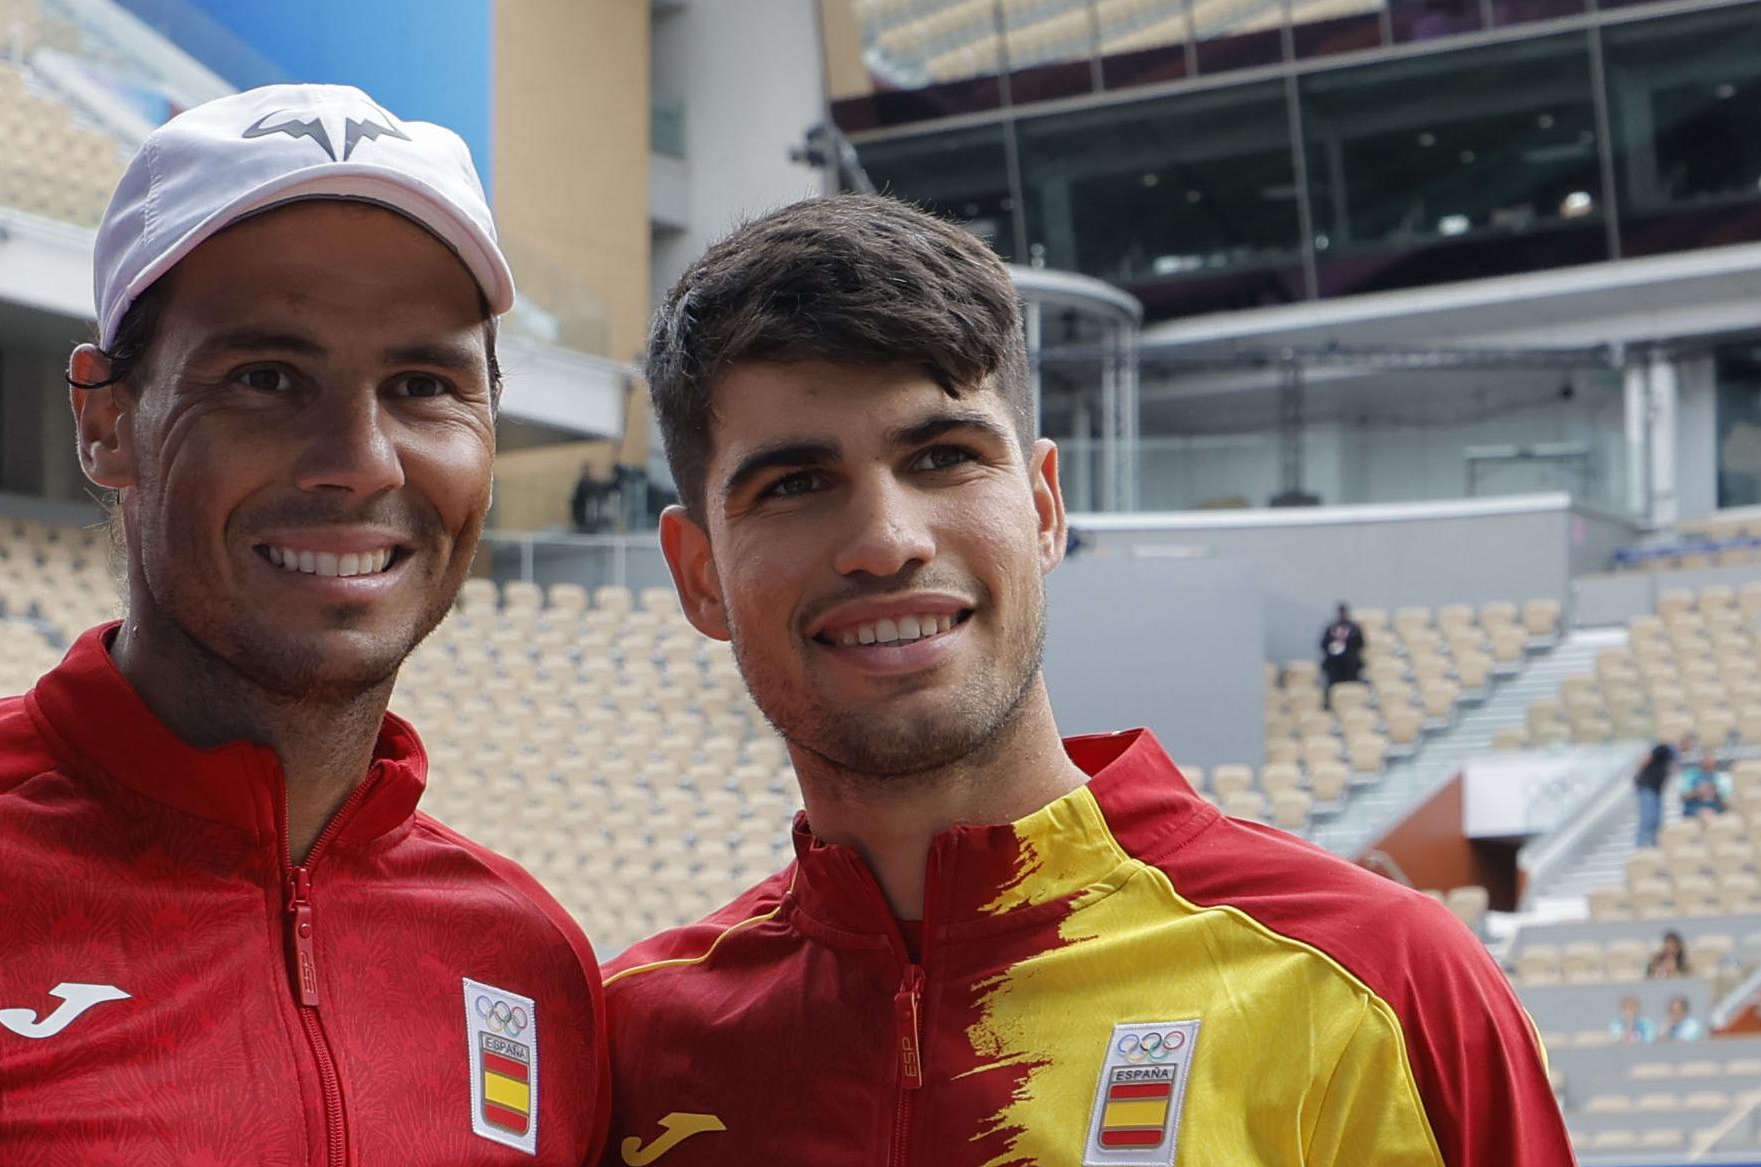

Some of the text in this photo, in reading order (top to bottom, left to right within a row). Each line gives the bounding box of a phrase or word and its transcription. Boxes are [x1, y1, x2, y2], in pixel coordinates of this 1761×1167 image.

[485, 1036, 527, 1059] ESPAÑA
[902, 1036, 917, 1077] ESP
[1115, 1066, 1170, 1081] ESPAÑA
